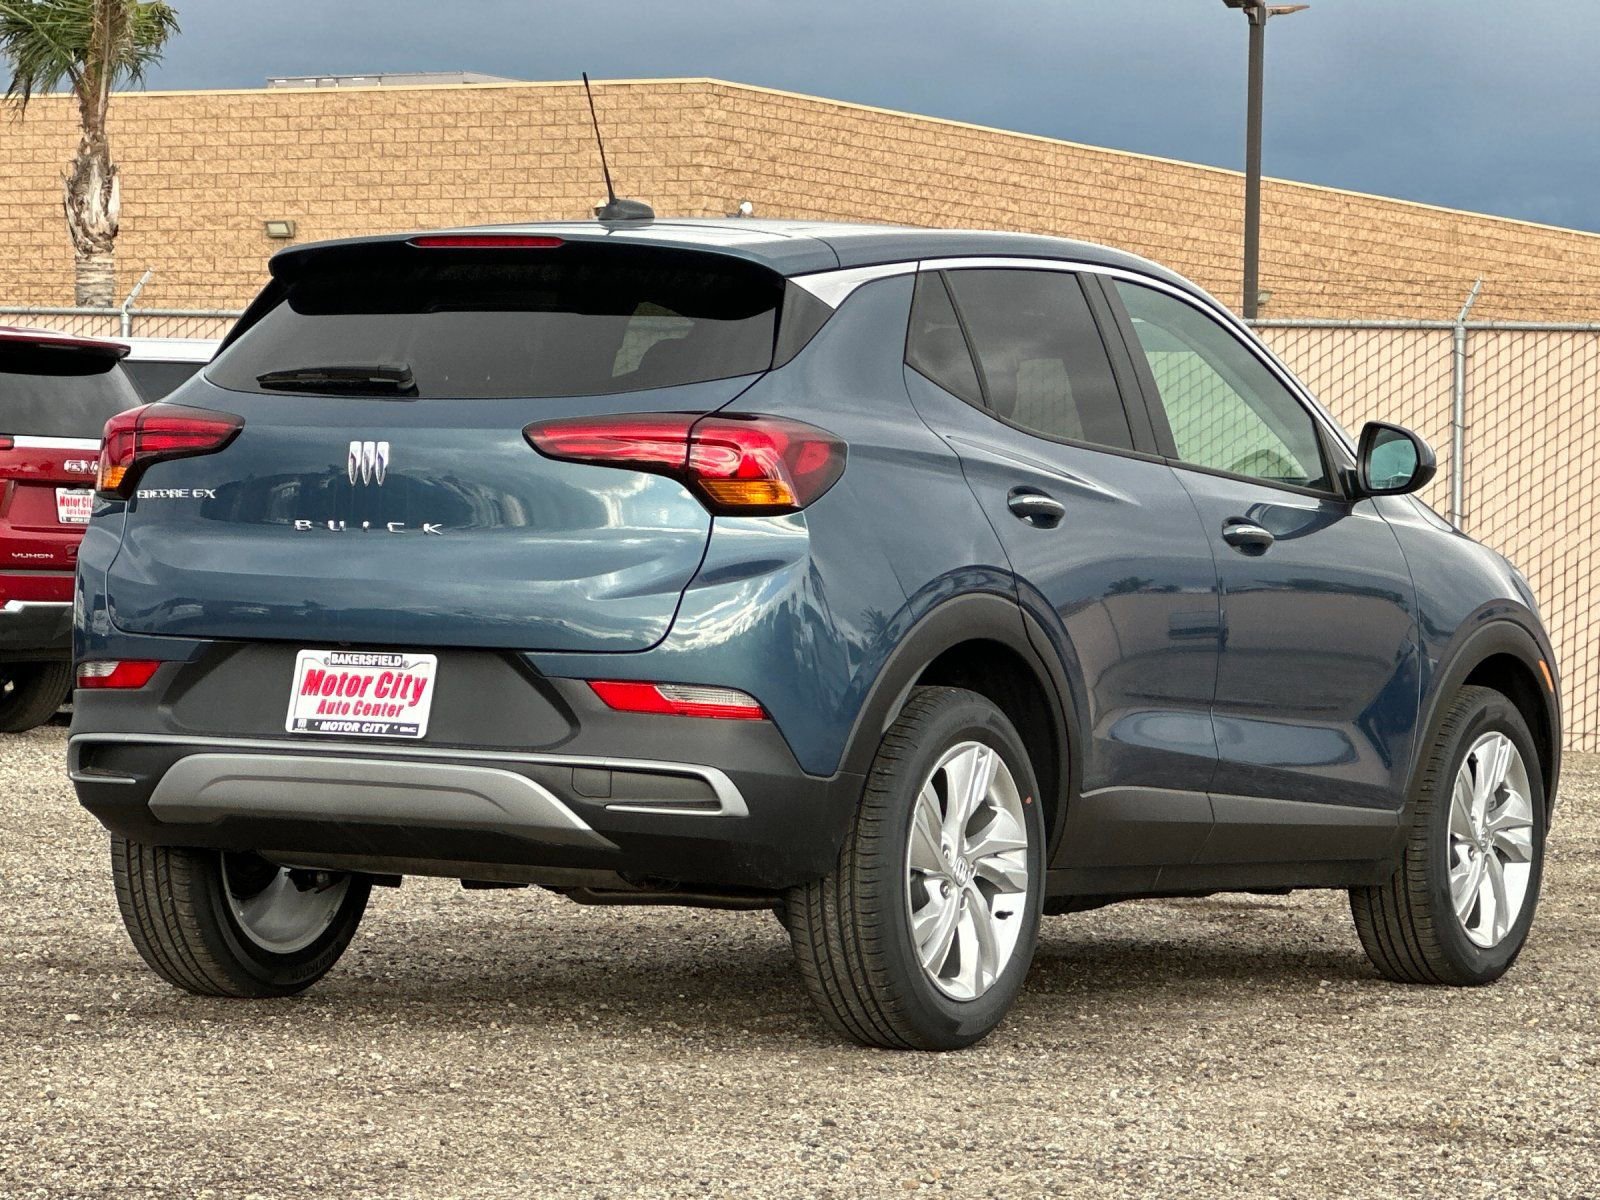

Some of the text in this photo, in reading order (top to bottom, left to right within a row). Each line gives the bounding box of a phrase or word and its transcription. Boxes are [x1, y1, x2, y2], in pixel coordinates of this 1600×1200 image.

[63, 459, 99, 475] GM
[136, 488, 216, 499] ENCORE GX
[82, 496, 93, 509] Cit
[294, 519, 443, 535] BUICK
[331, 653, 402, 667] BAKERSFIELD
[301, 668, 428, 707] Motor City
[316, 699, 404, 718] Auto Center
[320, 721, 361, 733] MOTOR
[361, 723, 390, 734] CITY
